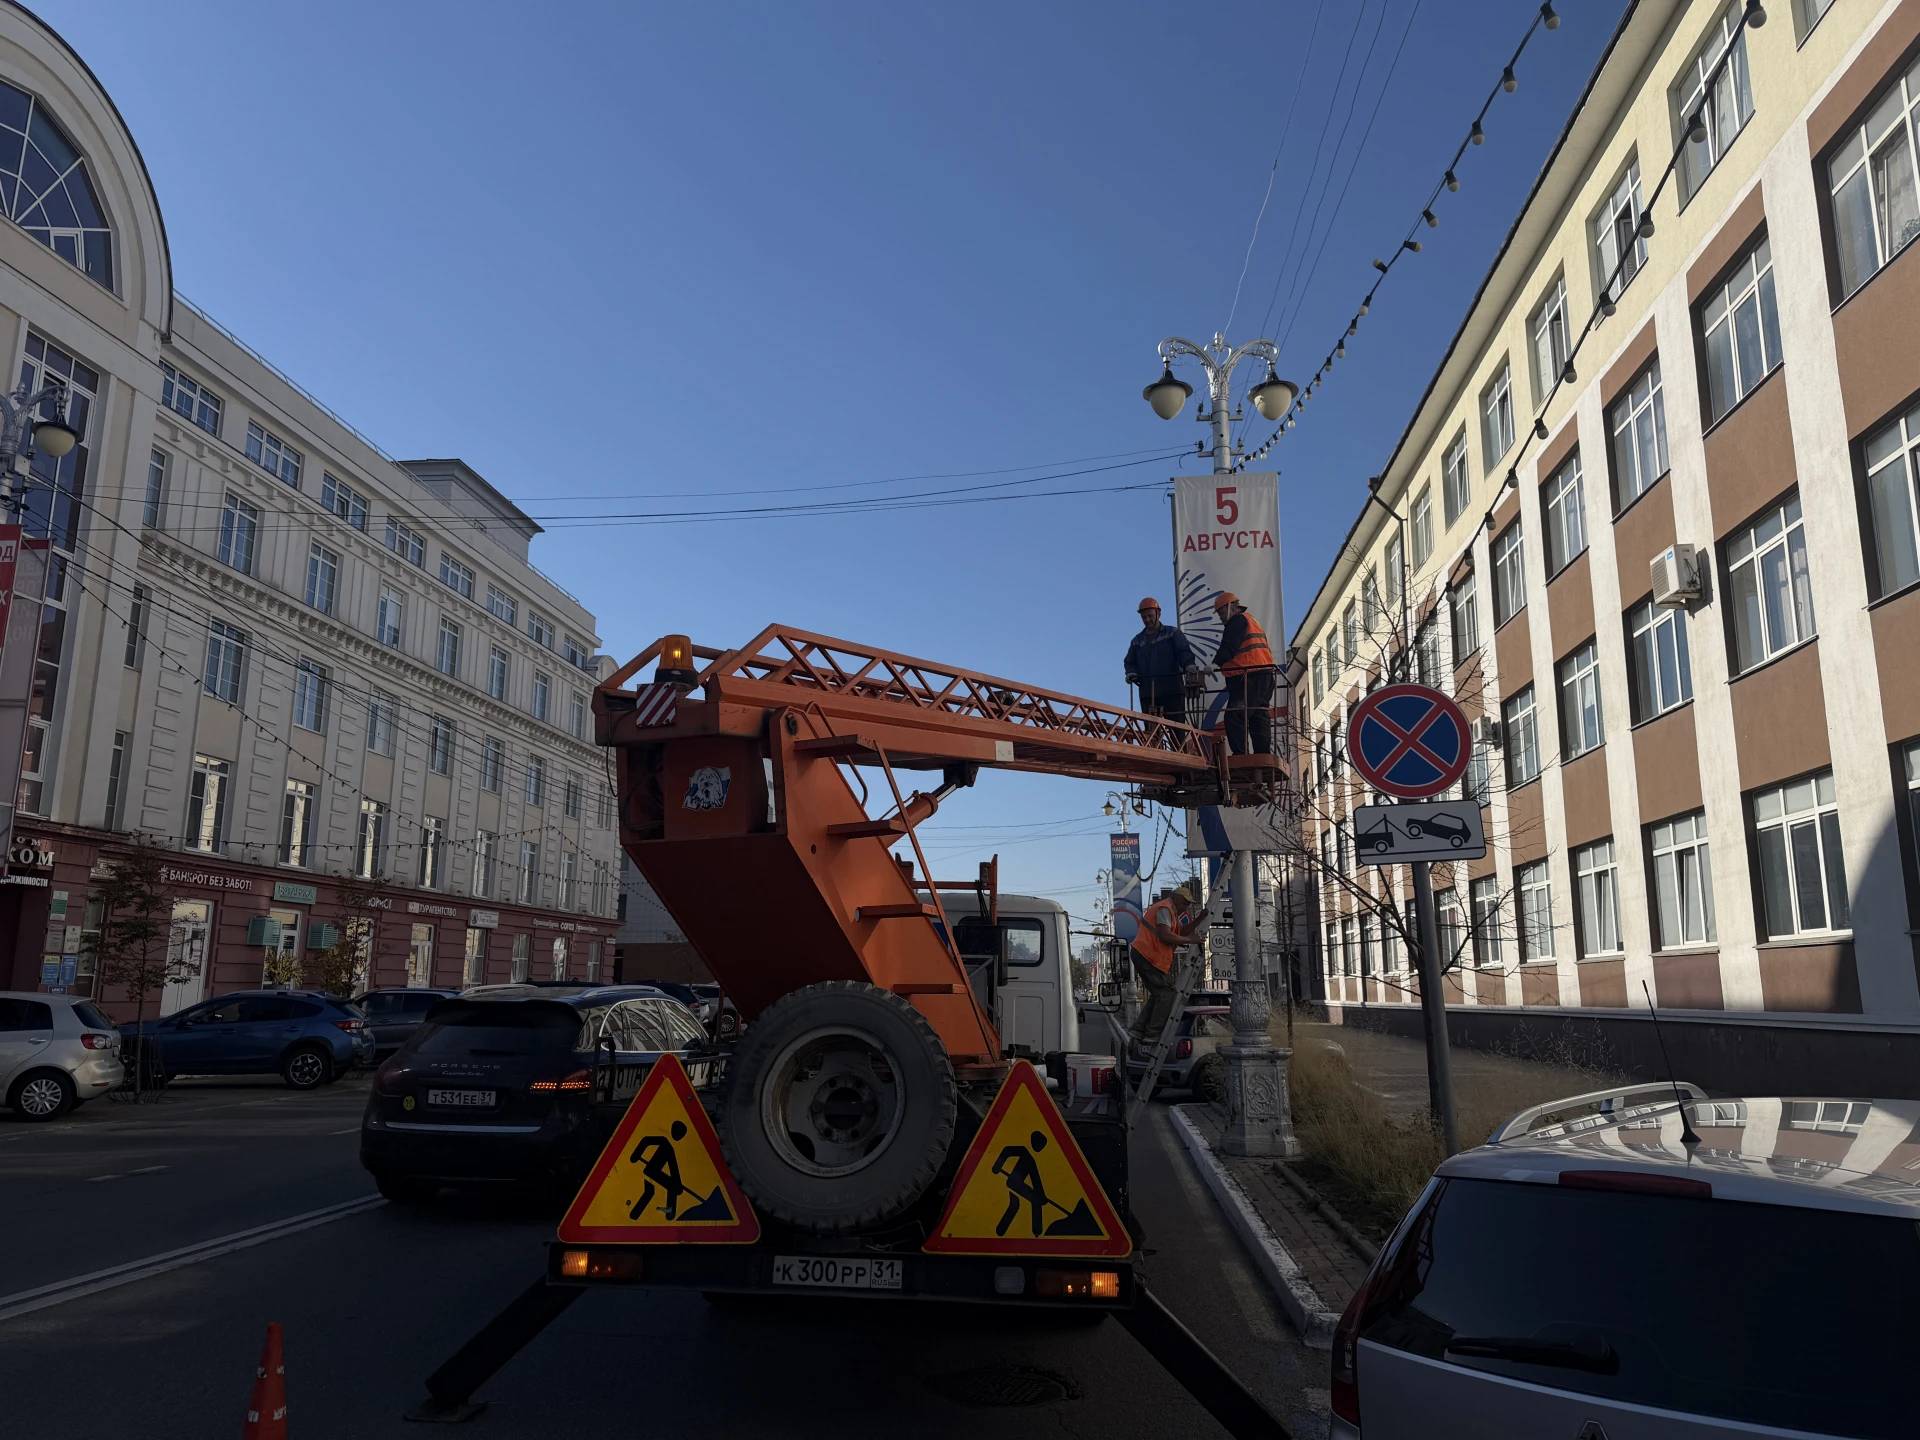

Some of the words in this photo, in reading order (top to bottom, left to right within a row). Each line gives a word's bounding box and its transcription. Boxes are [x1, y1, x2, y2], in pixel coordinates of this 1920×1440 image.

[1216, 487, 1239, 525] 5
[1183, 530, 1274, 552] АВГУСТА
[170, 870, 208, 885] БАНКРОТ
[209, 876, 224, 887] БЕЗ
[225, 878, 252, 890] ЗАБОТ!
[420, 904, 457, 917] ТУРАГЕНТСТВО
[873, 1261, 895, 1279] 31
[871, 1279, 888, 1287] RUS
